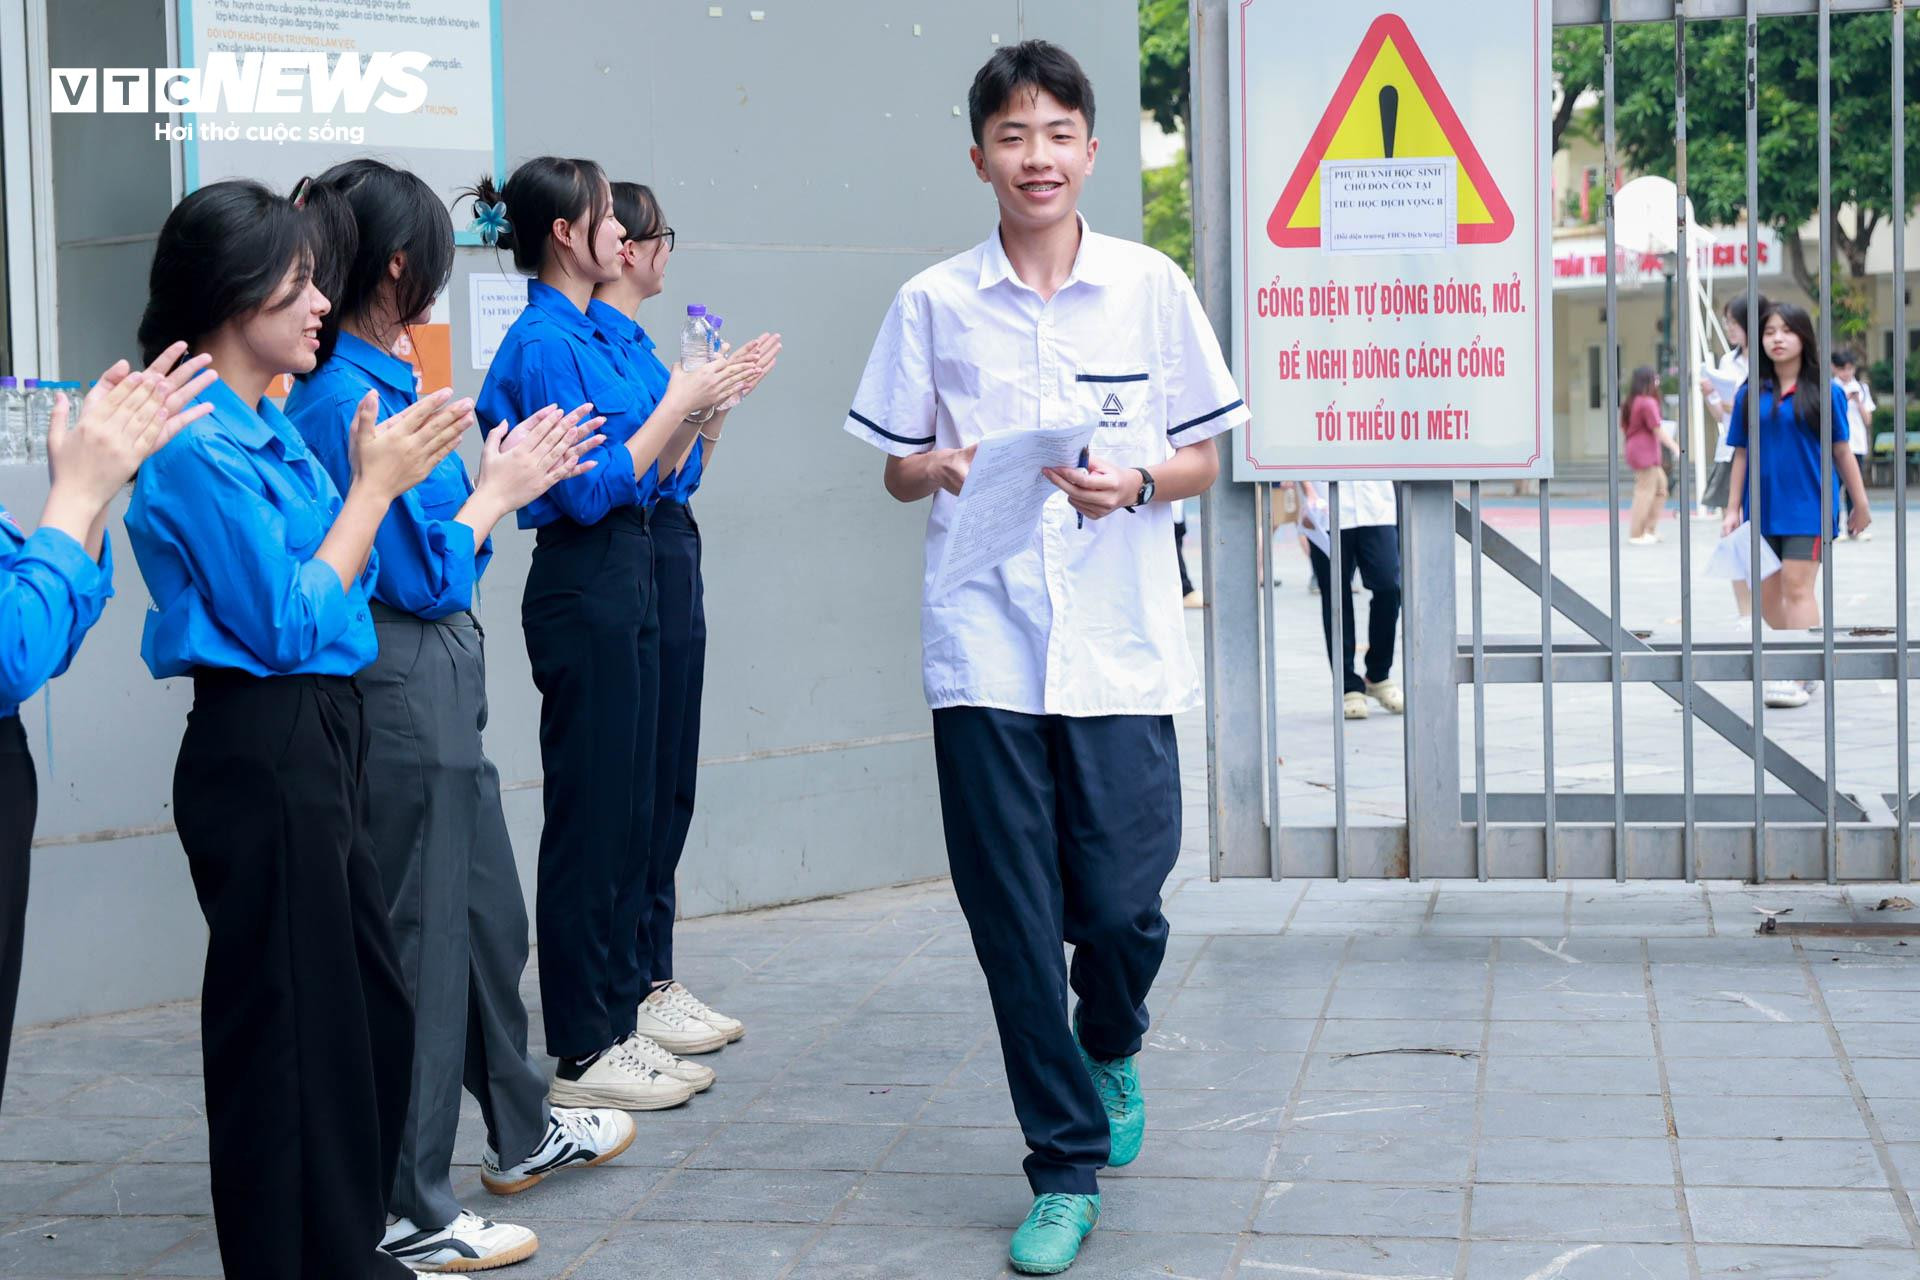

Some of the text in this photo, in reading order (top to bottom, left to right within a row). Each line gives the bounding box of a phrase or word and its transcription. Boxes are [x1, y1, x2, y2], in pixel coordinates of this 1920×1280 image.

[1394, 169, 1416, 179] HỌC
[1418, 168, 1441, 177] SINH
[1358, 199, 1378, 209] HỌC
[1381, 199, 1404, 208] DỊCH
[1407, 198, 1434, 208] VỌNG
[1257, 272, 1526, 323] CỔNG ĐIỆN TỰ ĐỘNG ĐÓNG, MỞ.
[1279, 335, 1505, 386] ĐỀ NGHỊ ĐỨNG CÁCH CỔNG
[1315, 398, 1470, 441] TỐI THIỂU 01 MÉT!
